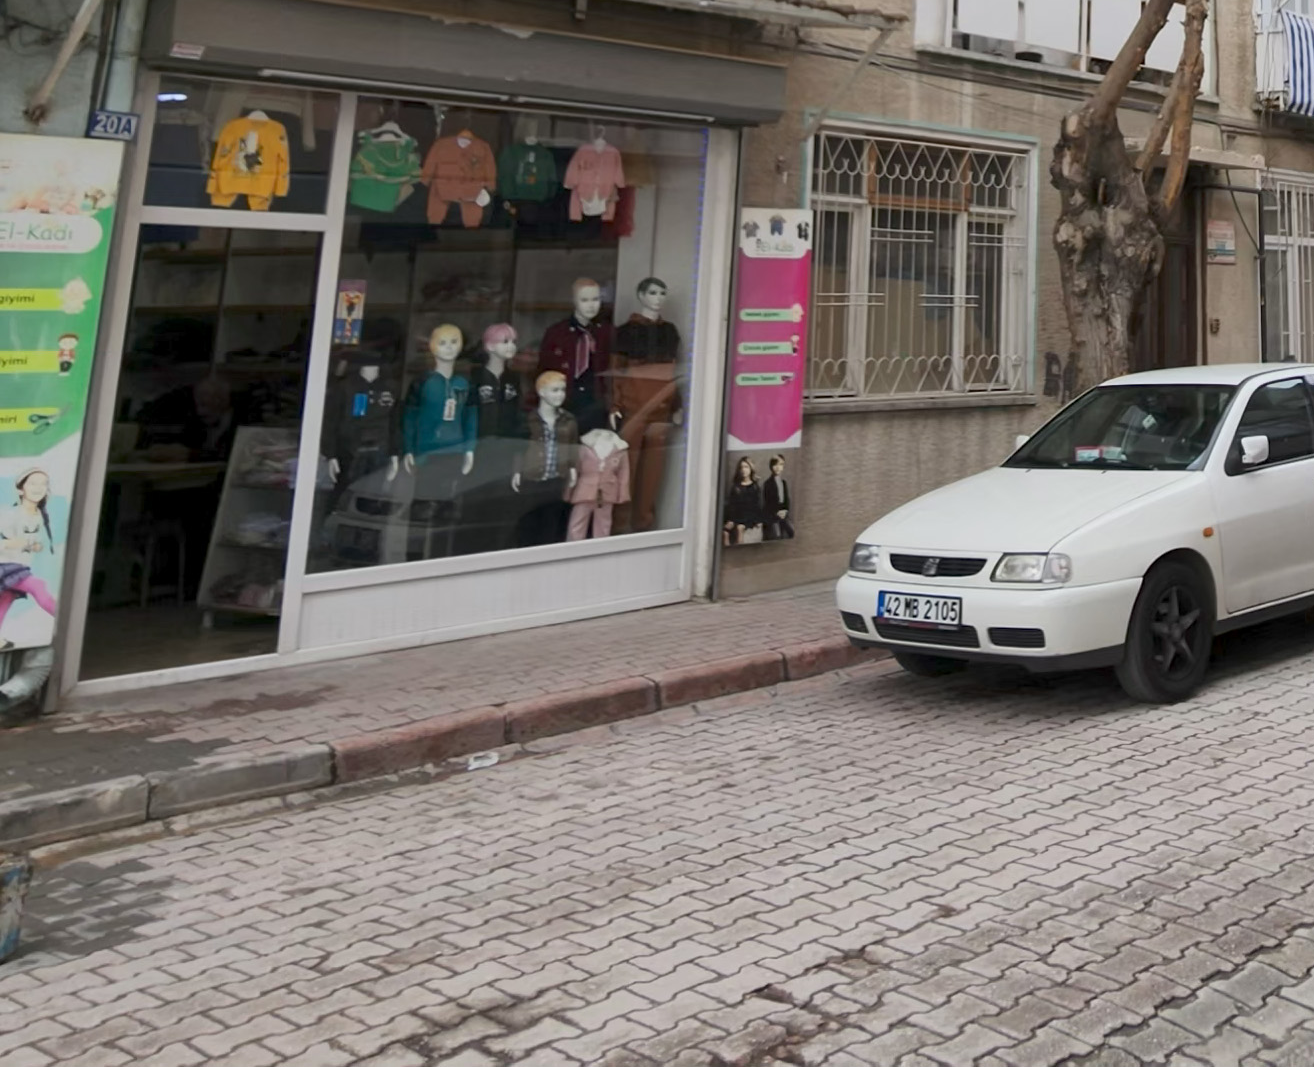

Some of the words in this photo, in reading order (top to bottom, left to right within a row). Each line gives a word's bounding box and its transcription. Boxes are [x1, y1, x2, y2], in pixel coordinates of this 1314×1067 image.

[885, 595, 901, 617] 42
[903, 597, 920, 619] MB
[923, 599, 959, 622] 2105
